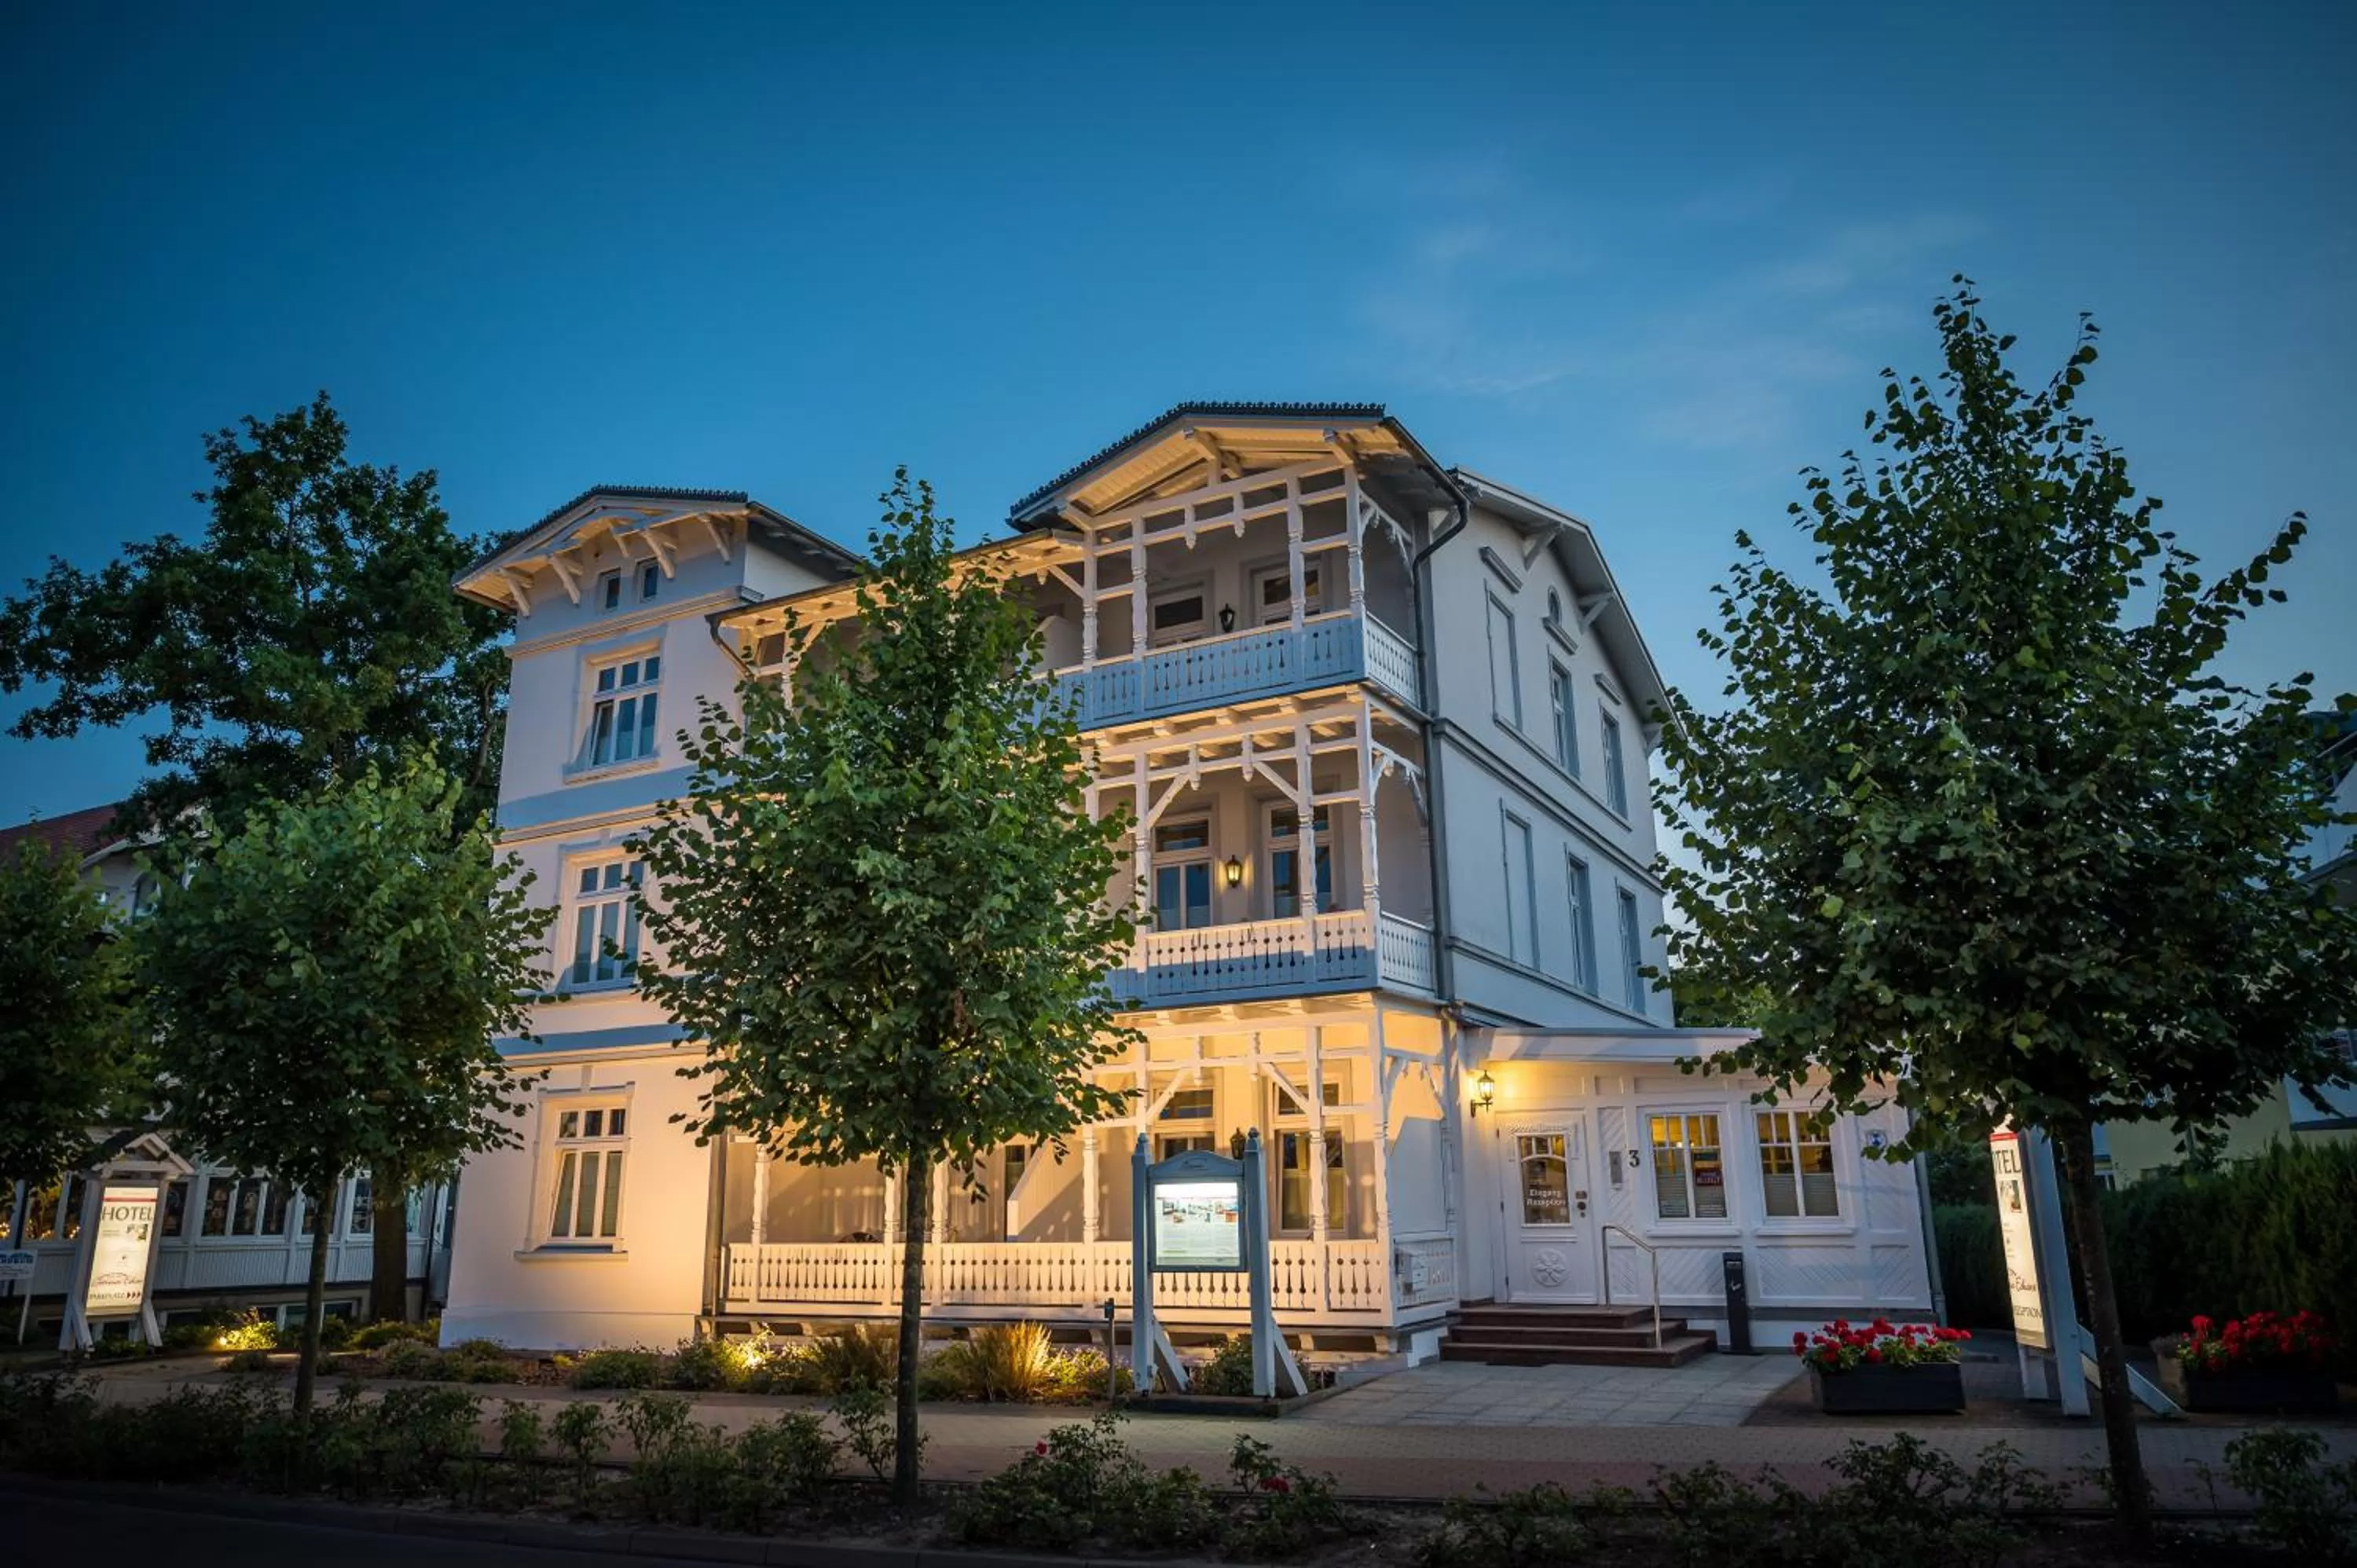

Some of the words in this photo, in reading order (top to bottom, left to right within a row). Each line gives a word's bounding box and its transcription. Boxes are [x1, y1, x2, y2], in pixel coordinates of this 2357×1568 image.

[1629, 1149, 1640, 1167] 3
[1993, 1149, 2022, 1174] TEL
[101, 1206, 153, 1222] HOTEL
